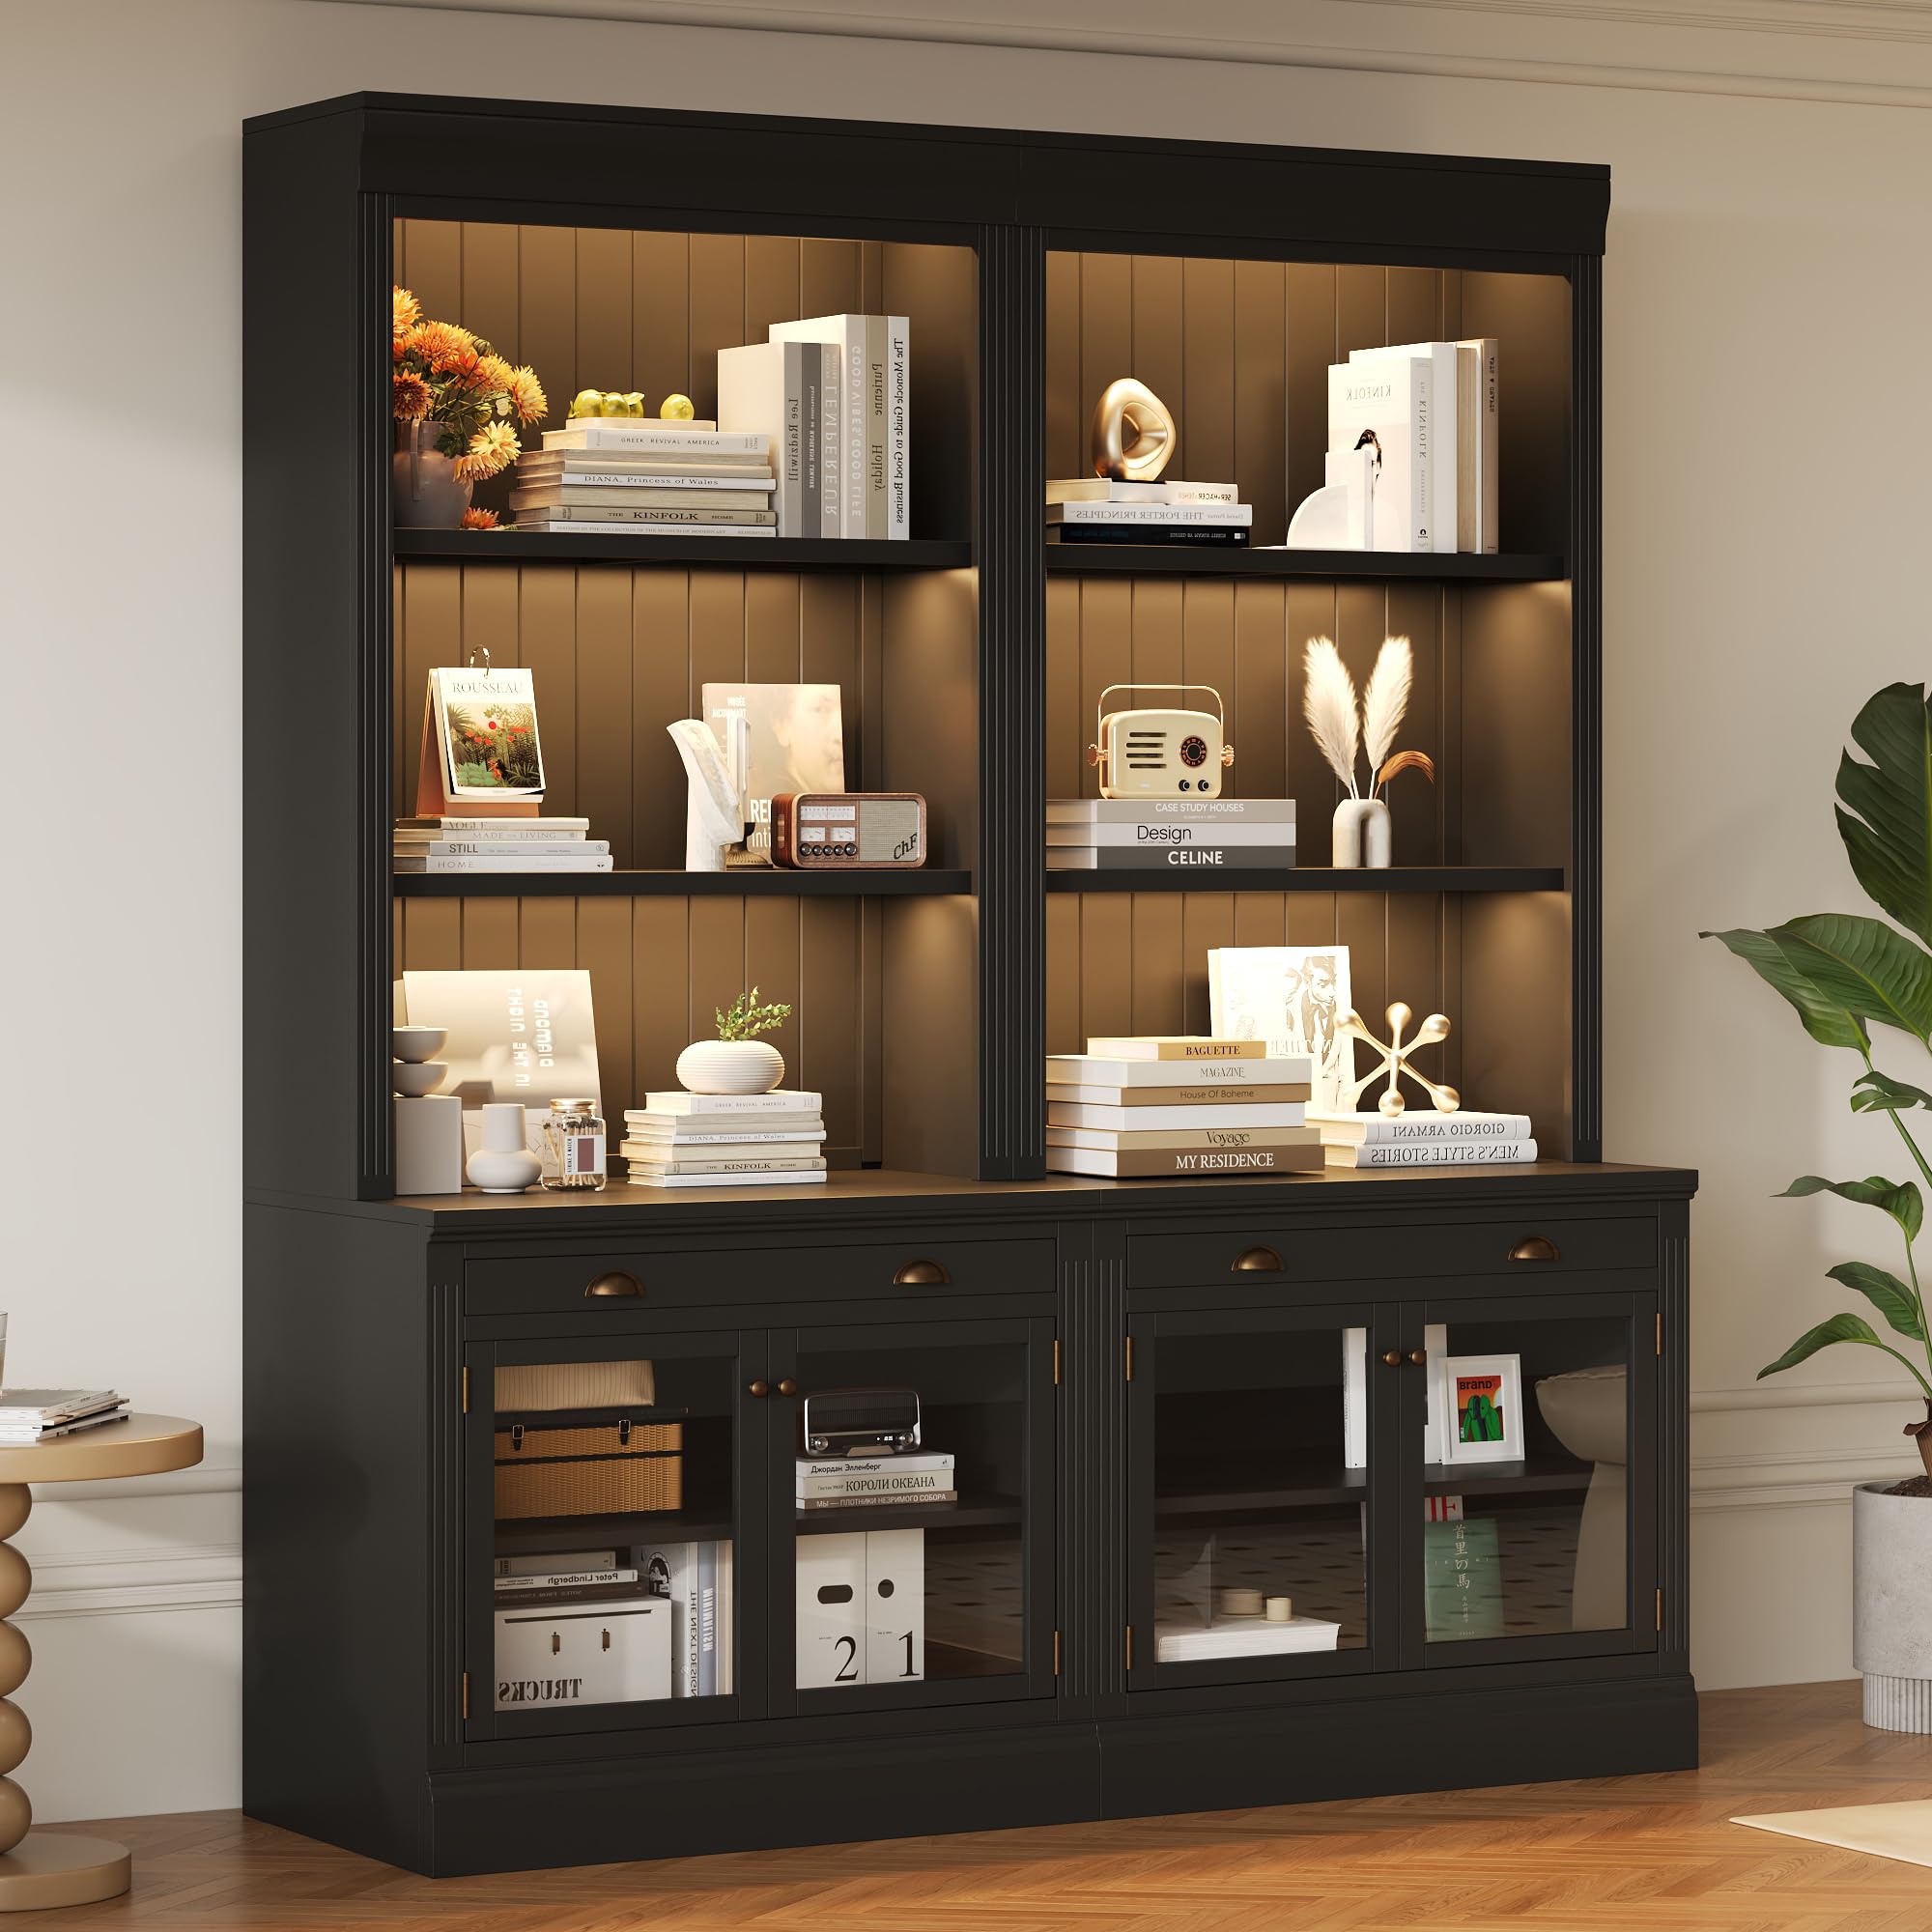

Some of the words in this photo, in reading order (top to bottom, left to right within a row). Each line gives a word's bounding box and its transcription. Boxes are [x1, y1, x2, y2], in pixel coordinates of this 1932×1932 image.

[627, 476, 671, 485] Princess
[689, 477, 719, 486] Wales
[633, 511, 699, 521] KINFOLK
[452, 681, 523, 695] ROUSSEAU
[1155, 803, 1179, 812] CASE
[1179, 803, 1208, 812] STUDY
[1209, 803, 1244, 812] HOUSES
[1137, 825, 1192, 844] Design
[449, 843, 479, 854] STILL
[1167, 850, 1224, 866] CELINE
[1185, 1045, 1240, 1056] BAGUETTE
[1200, 1066, 1245, 1078] MAGAZINE
[1179, 1091, 1207, 1099] House
[1208, 1090, 1219, 1098] Of
[1221, 1089, 1255, 1098] Boheme
[1207, 1131, 1250, 1147] Voyage
[1176, 1154, 1198, 1169] MY
[1200, 1152, 1274, 1169] RESIDENCE
[810, 1465, 843, 1474] Джордан
[844, 1463, 882, 1472] Элленберг
[845, 1479, 890, 1492] КОРОЛИ
[892, 1476, 936, 1489] ОКЕАНА
[839, 1497, 878, 1507] ПЛОТНИКИ
[878, 1495, 919, 1504] НЕЗРИМОГО
[920, 1493, 947, 1502] СОБОРА
[1452, 1524, 1470, 1589] 首里の馬
[834, 1635, 860, 1682] 2
[898, 1631, 921, 1677] 1
